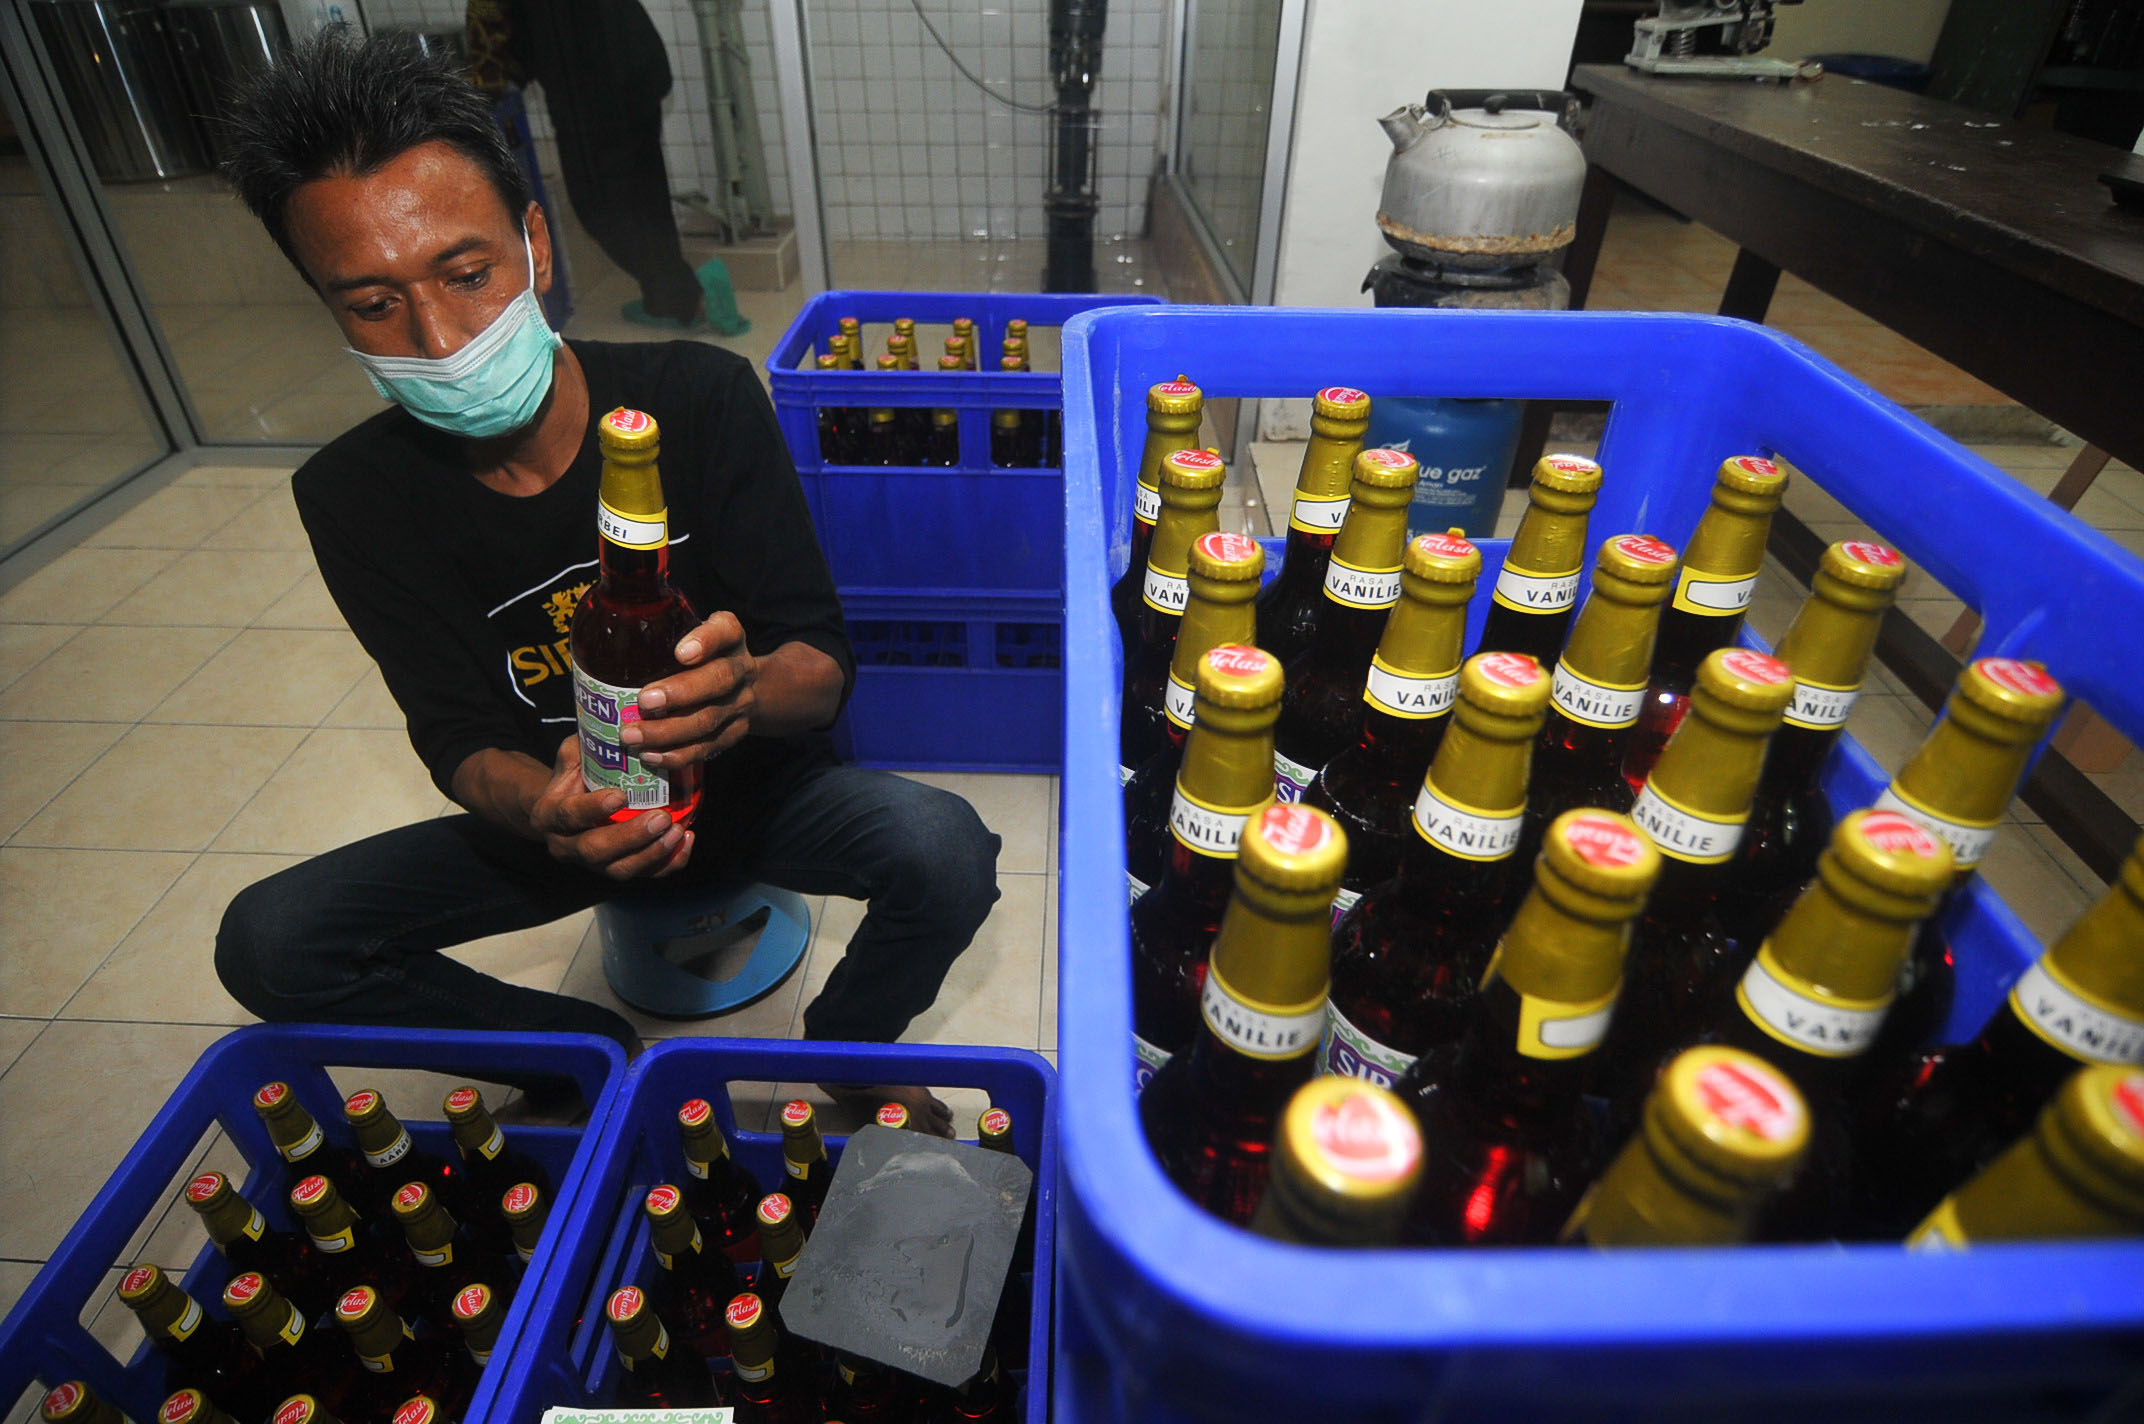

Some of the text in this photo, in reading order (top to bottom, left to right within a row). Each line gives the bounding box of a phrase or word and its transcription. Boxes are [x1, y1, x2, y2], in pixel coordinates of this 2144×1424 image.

[1419, 466, 1482, 484] ue gaz
[1331, 576, 1400, 600] VANILIE
[1350, 575, 1384, 585] RASA
[1150, 583, 1184, 605] VAN
[1553, 681, 1632, 717] VANILIE
[1574, 686, 1612, 702] RASA
[584, 737, 620, 762] SIH
[1184, 807, 1223, 827] RASA
[1425, 813, 1519, 849] VANILIE
